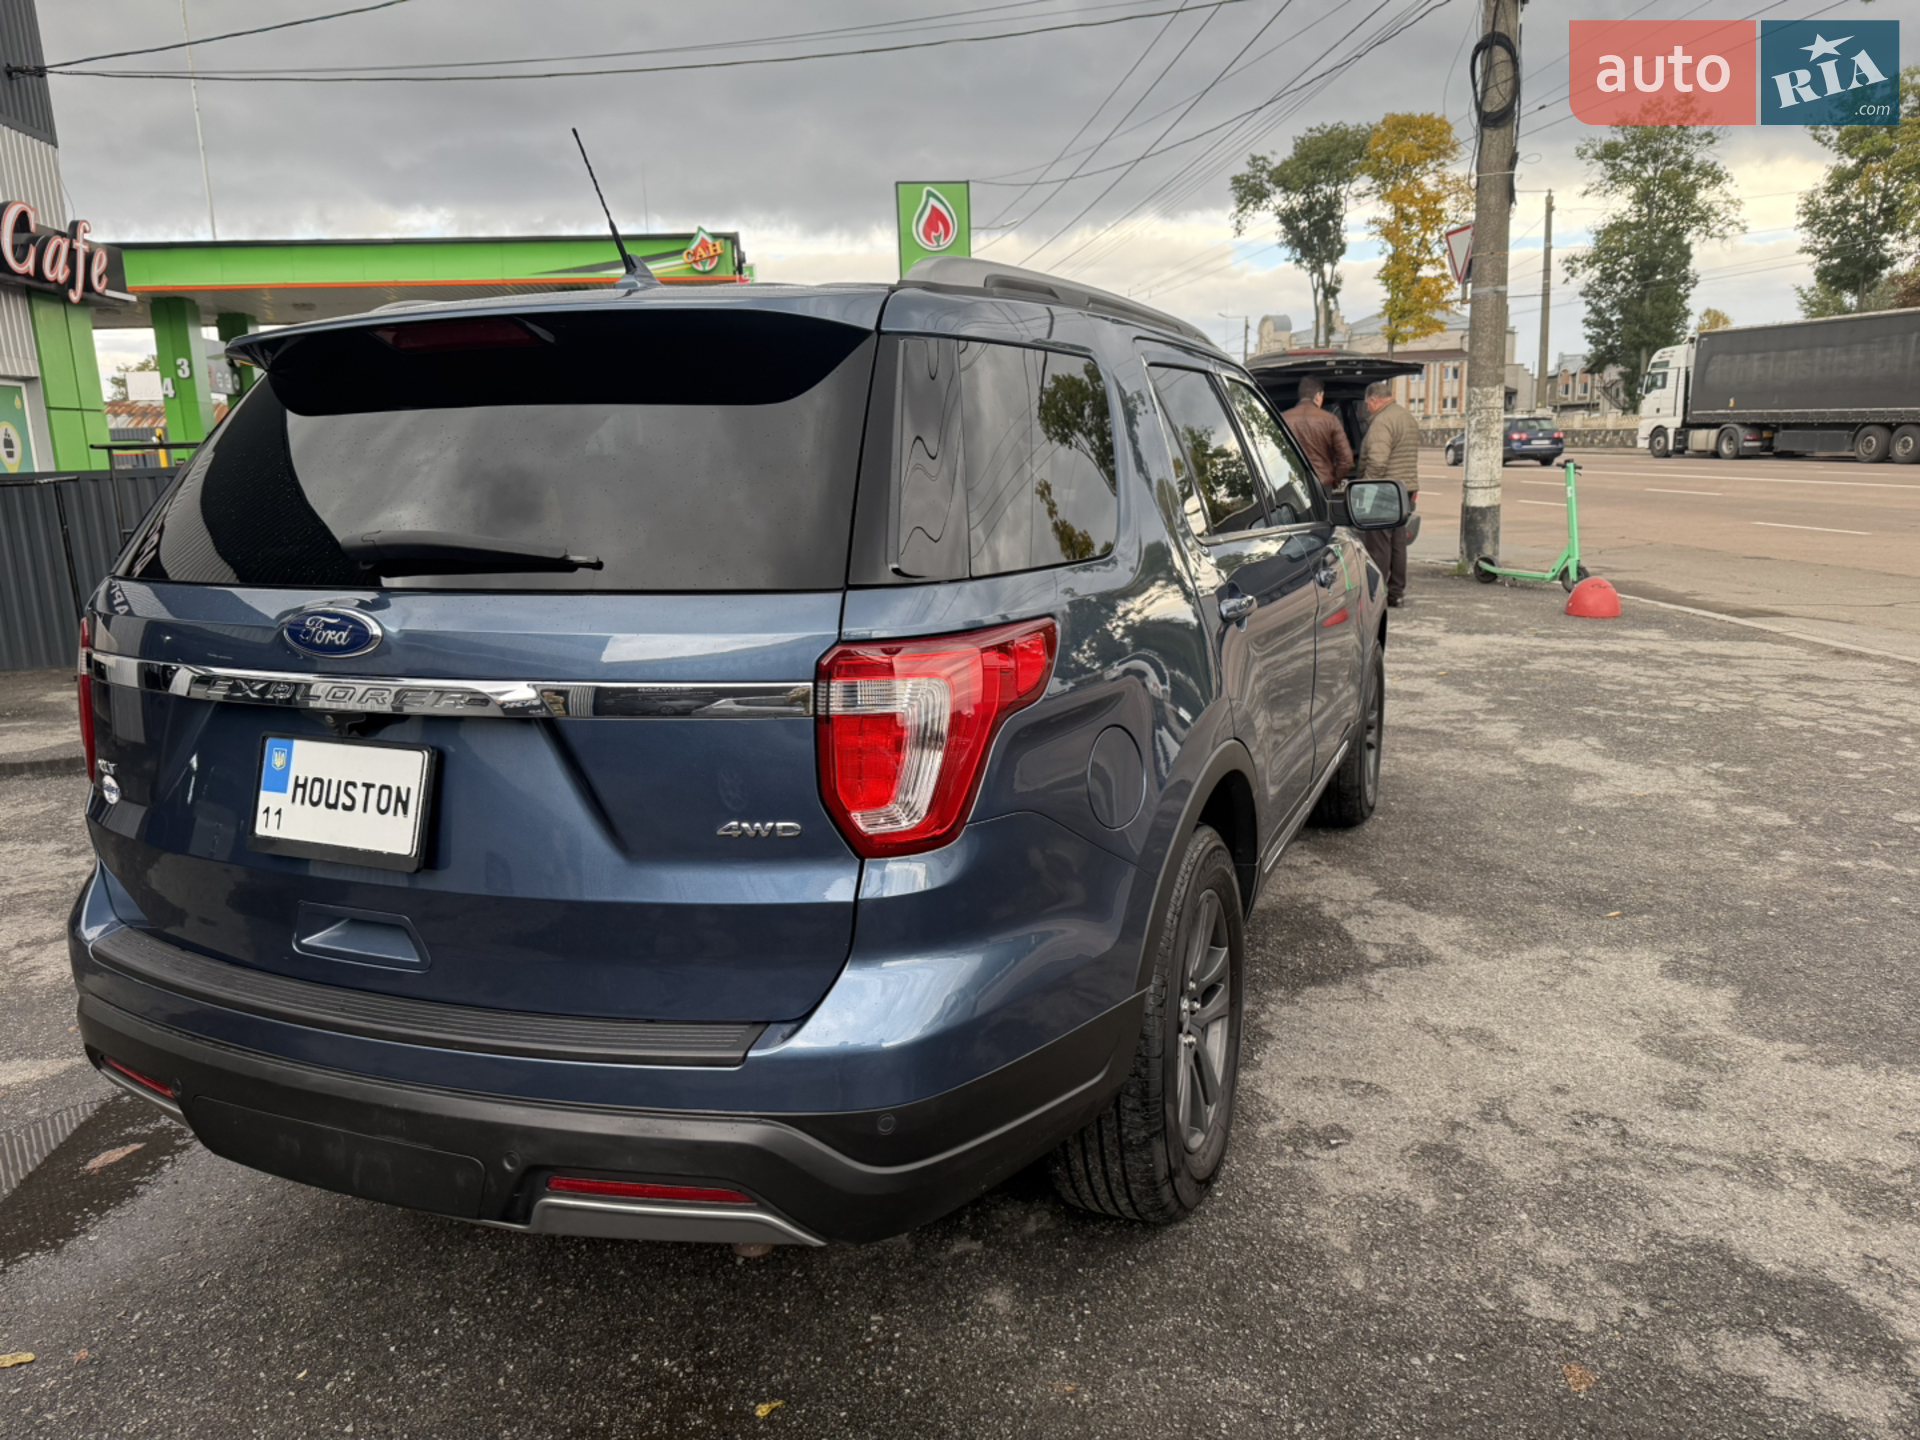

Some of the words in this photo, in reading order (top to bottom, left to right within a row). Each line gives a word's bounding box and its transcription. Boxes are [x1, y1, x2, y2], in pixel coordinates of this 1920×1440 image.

[1, 202, 108, 303] Cafe
[176, 357, 190, 379] 3
[163, 377, 175, 398] 4
[300, 615, 353, 645] Ford
[291, 774, 411, 818] HOUSTON
[262, 806, 282, 830] 11
[716, 821, 802, 837] 4WD
